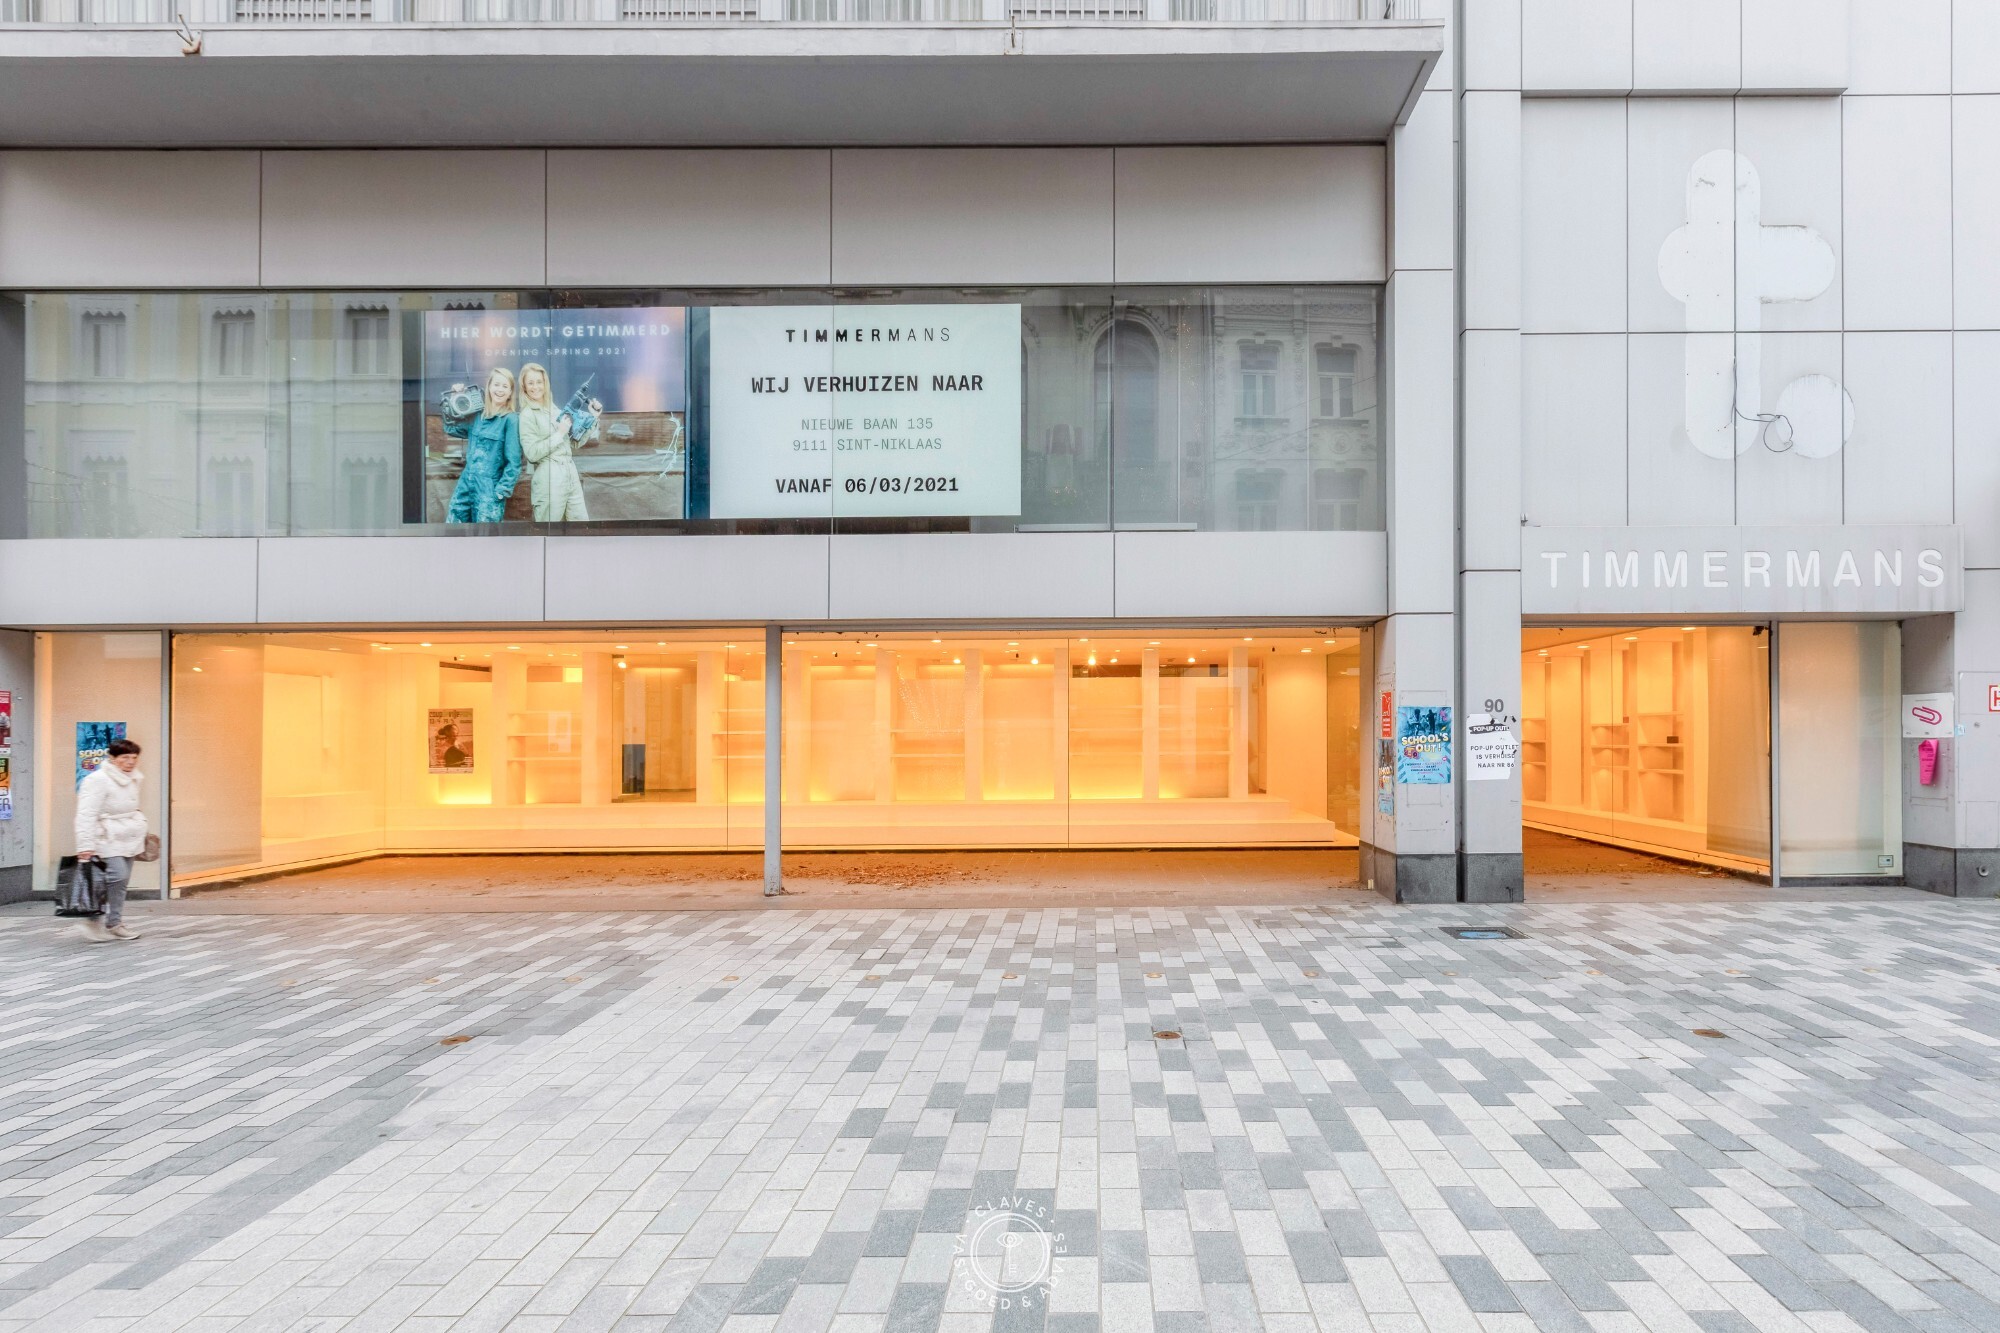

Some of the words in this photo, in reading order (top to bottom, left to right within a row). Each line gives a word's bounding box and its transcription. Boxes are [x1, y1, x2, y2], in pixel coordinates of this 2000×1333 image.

[441, 327, 480, 338] HIER
[490, 326, 553, 338] WORDT
[562, 324, 670, 337] GETIMMERD
[785, 327, 951, 342] TIMMERMANS
[485, 348, 539, 357] OPENING
[546, 348, 590, 356] SPRING
[598, 347, 626, 355] 2021
[751, 376, 789, 393] WIJ
[803, 375, 918, 393] VERHUIZEN
[932, 375, 983, 391] NAAR
[801, 418, 854, 431] NIEUWE
[863, 418, 898, 430] BAAN
[907, 417, 933, 430] 135
[792, 439, 827, 451] 9111
[836, 438, 942, 451] SINT-NIKLAAS
[775, 478, 832, 494] VANAF
[845, 476, 959, 493] 06/03/2021
[1540, 549, 1945, 588] TIMMERMANS
[1484, 698, 1504, 713] 90
[1401, 732, 1449, 746] SCHOOL'S
[1416, 743, 1441, 753] OUT!
